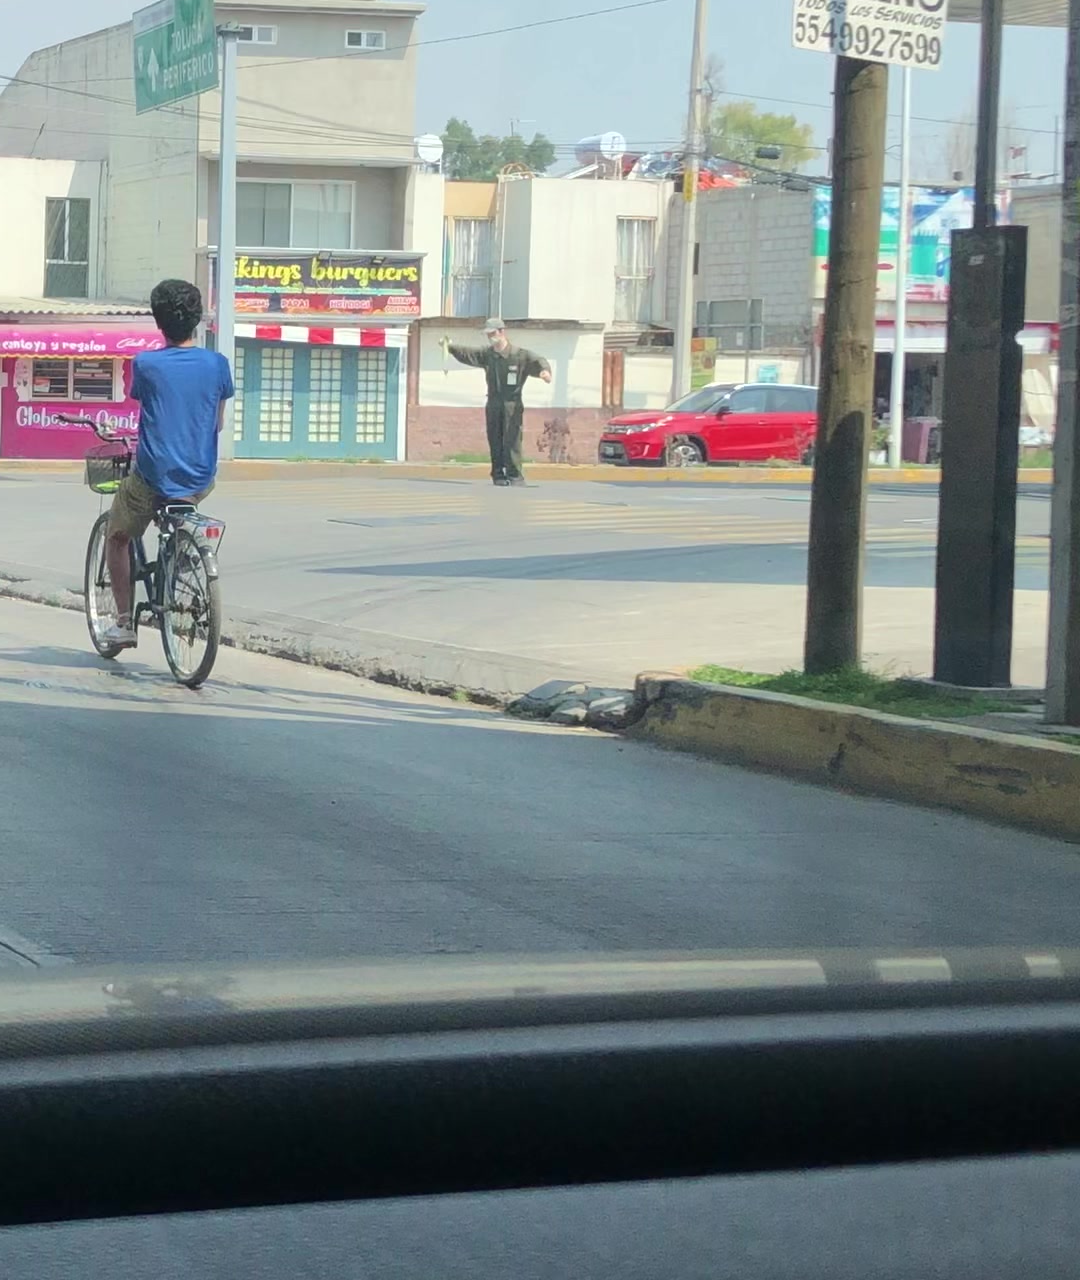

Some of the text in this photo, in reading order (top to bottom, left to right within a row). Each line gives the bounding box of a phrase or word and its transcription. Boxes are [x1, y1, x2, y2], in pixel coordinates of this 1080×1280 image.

[849, 4, 871, 18] LOS
[873, 5, 943, 30] SERVICIOS
[794, 12, 942, 65] 5549927599
[163, 51, 214, 90] PERIFERICO
[234, 255, 302, 286] ikings
[50, 341, 59, 351] y
[62, 339, 106, 353] regalos
